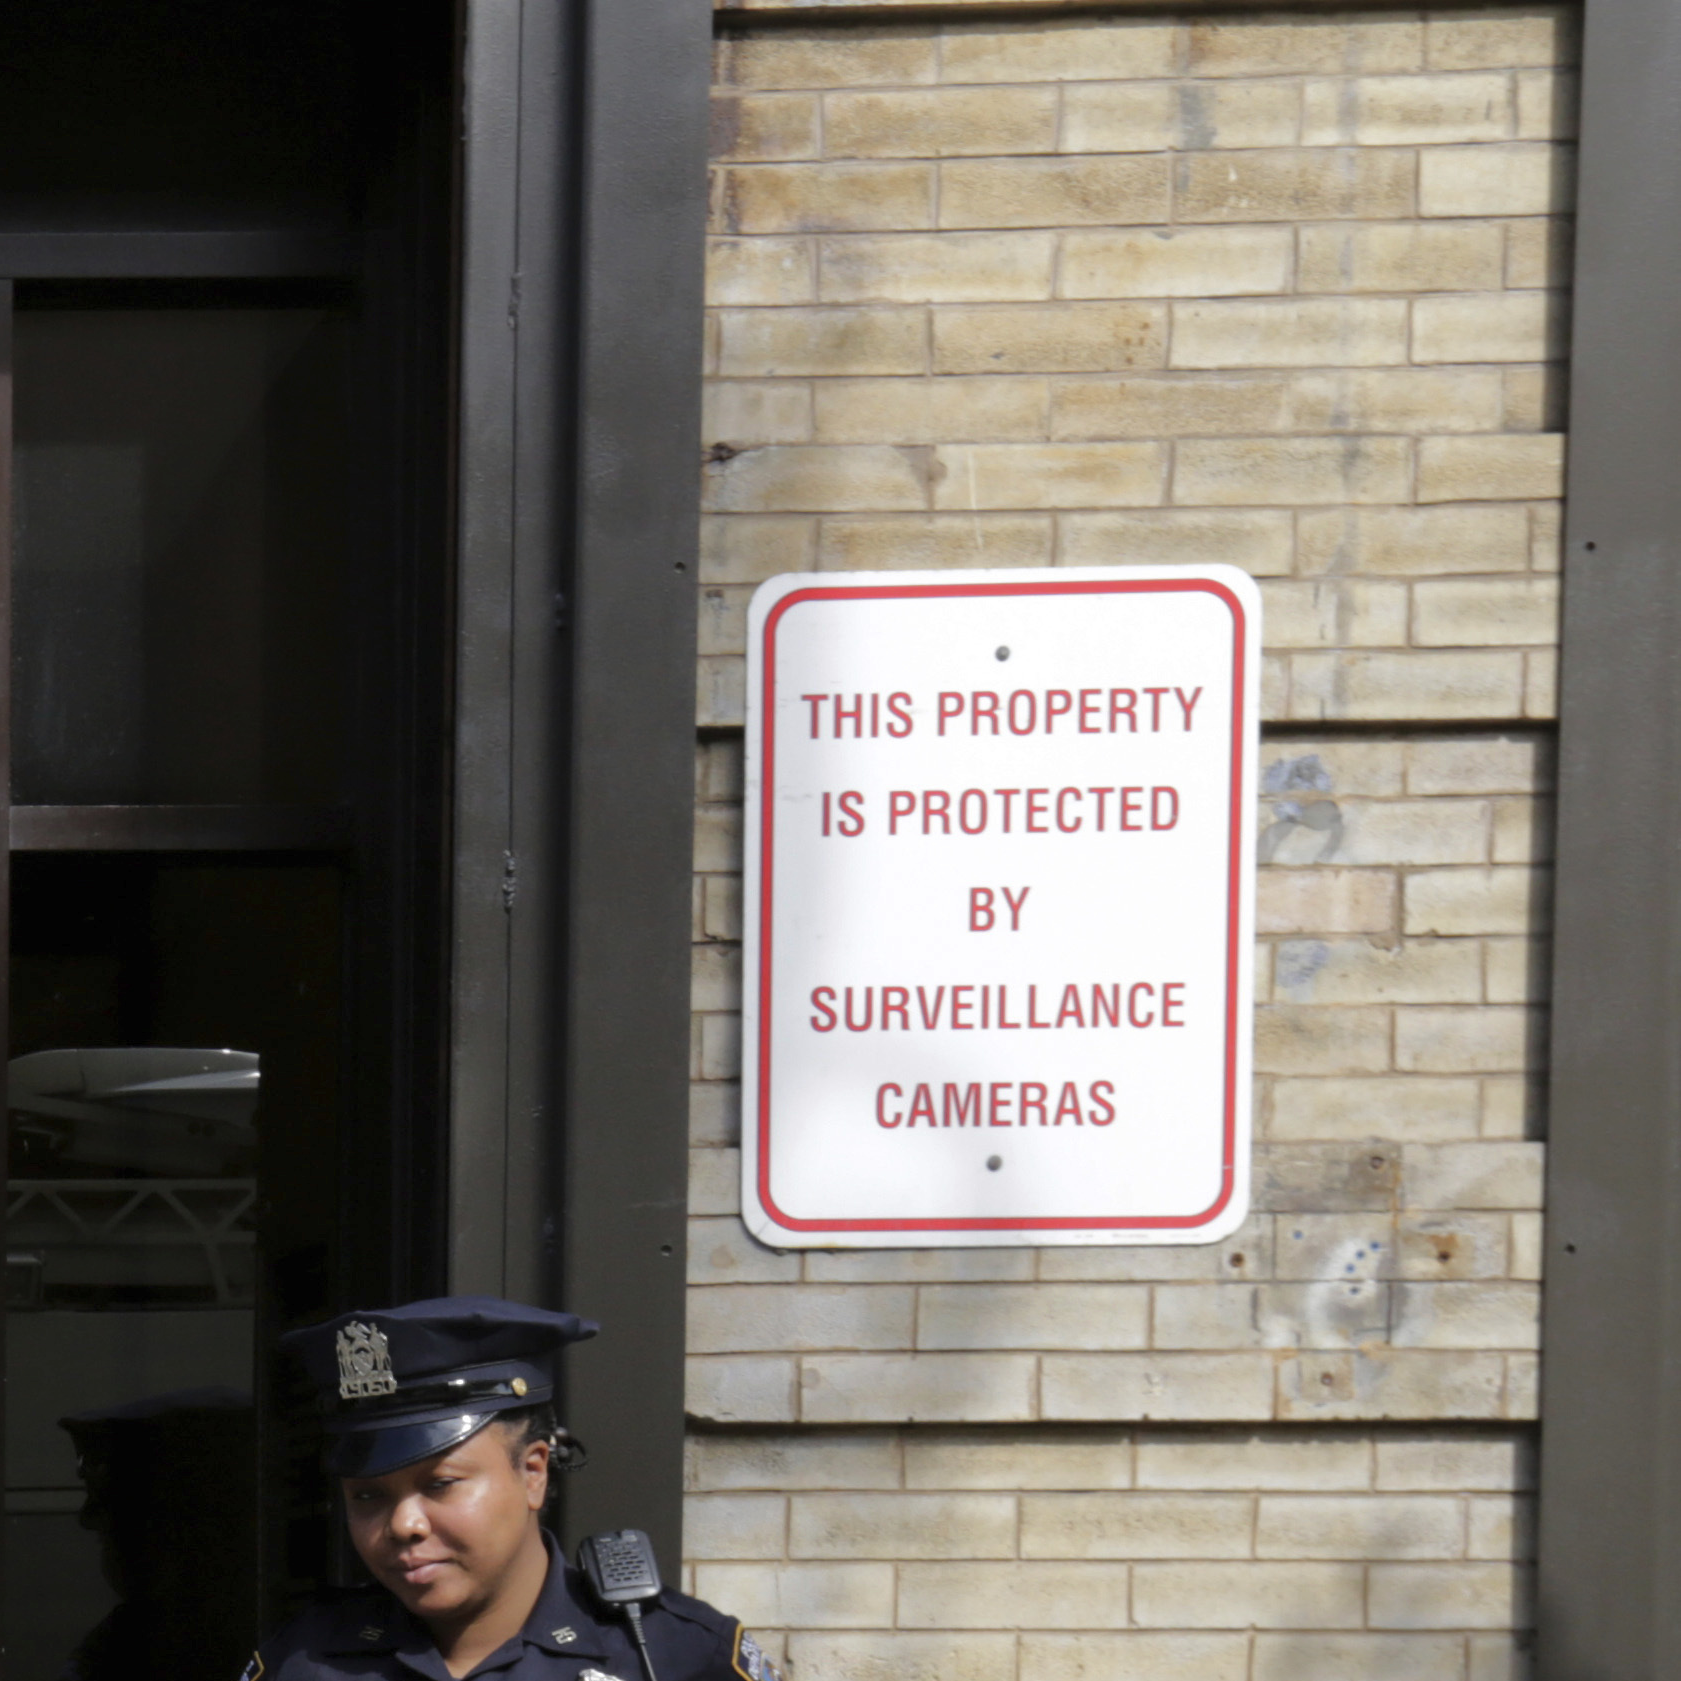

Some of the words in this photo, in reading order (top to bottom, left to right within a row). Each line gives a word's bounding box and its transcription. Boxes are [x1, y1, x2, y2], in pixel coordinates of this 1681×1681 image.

[801, 691, 916, 740] THIS
[936, 686, 1204, 737] PROPERTY
[821, 791, 866, 838] IS
[888, 785, 1181, 836] PROTECTED
[968, 886, 1031, 932] BY
[809, 982, 1186, 1033] SURVEILLANCE
[875, 1080, 1117, 1129] CAMERAS
